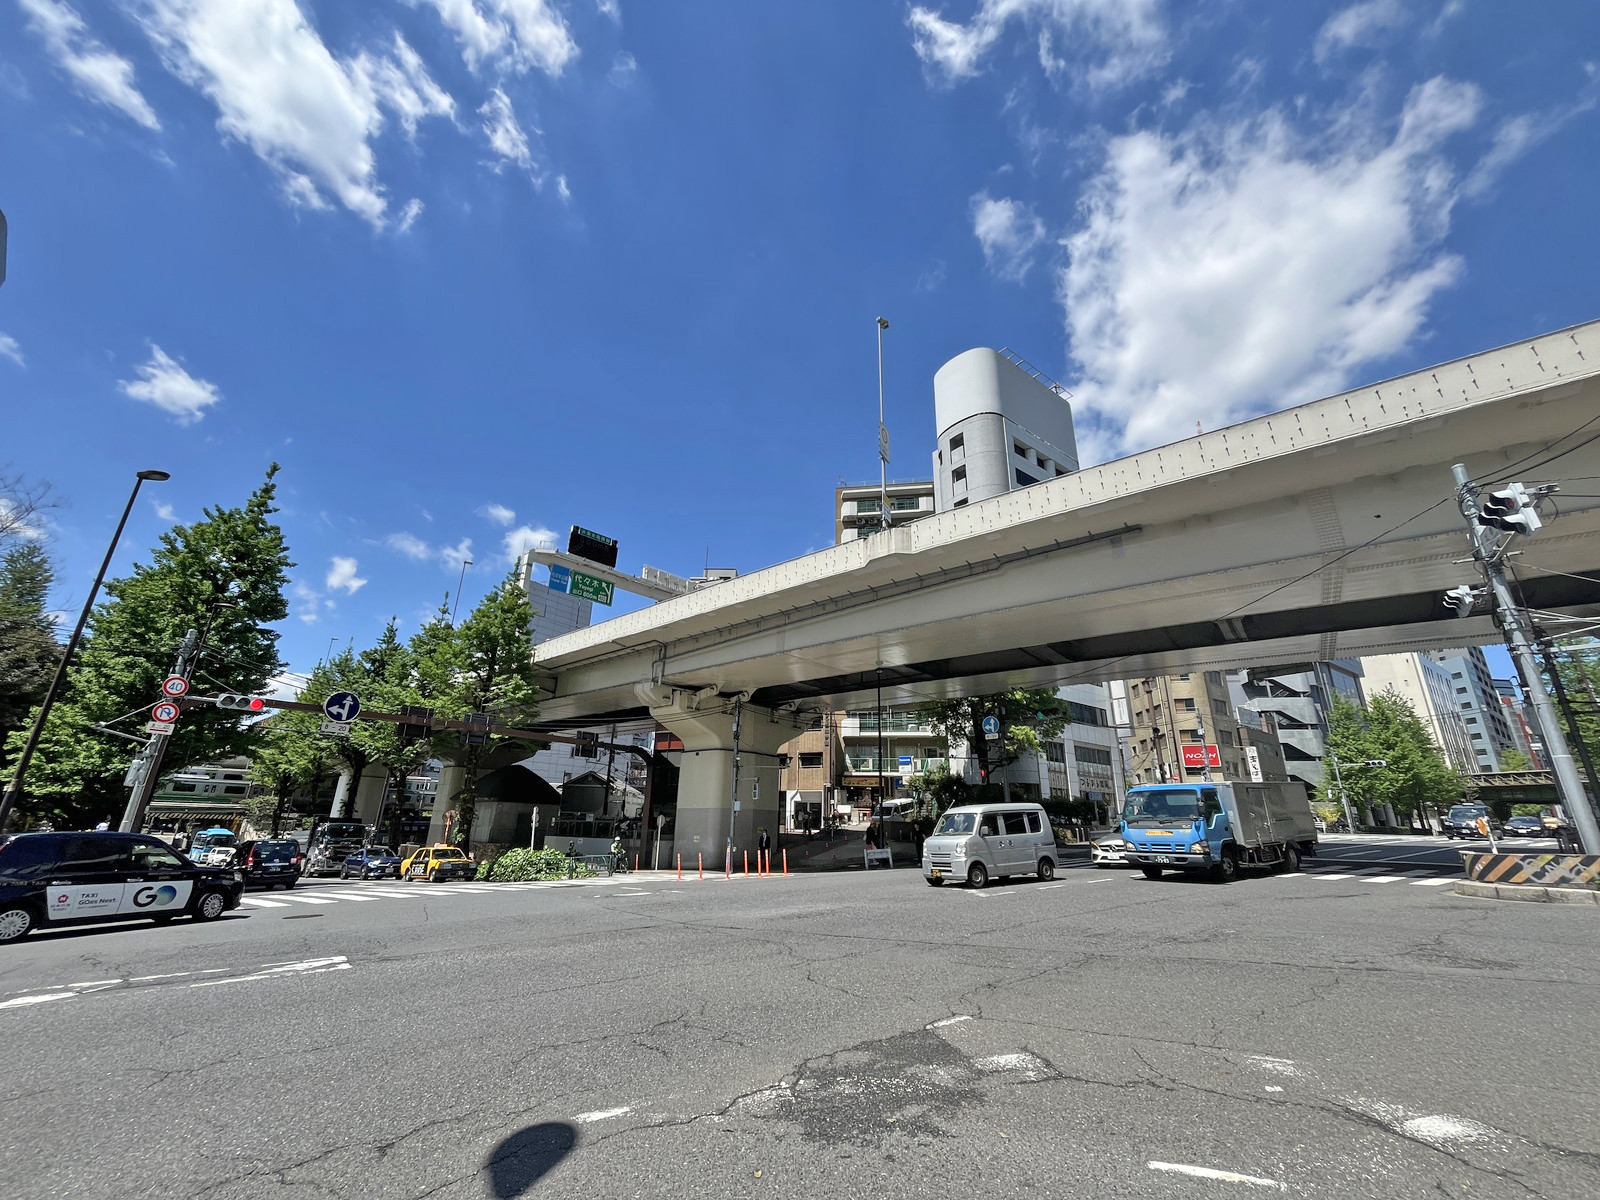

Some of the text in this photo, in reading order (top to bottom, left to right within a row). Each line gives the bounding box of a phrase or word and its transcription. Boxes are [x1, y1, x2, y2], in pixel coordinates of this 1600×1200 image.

[574, 574, 599, 588] 代々木
[168, 682, 183, 691] 40
[133, 884, 177, 908] GO
